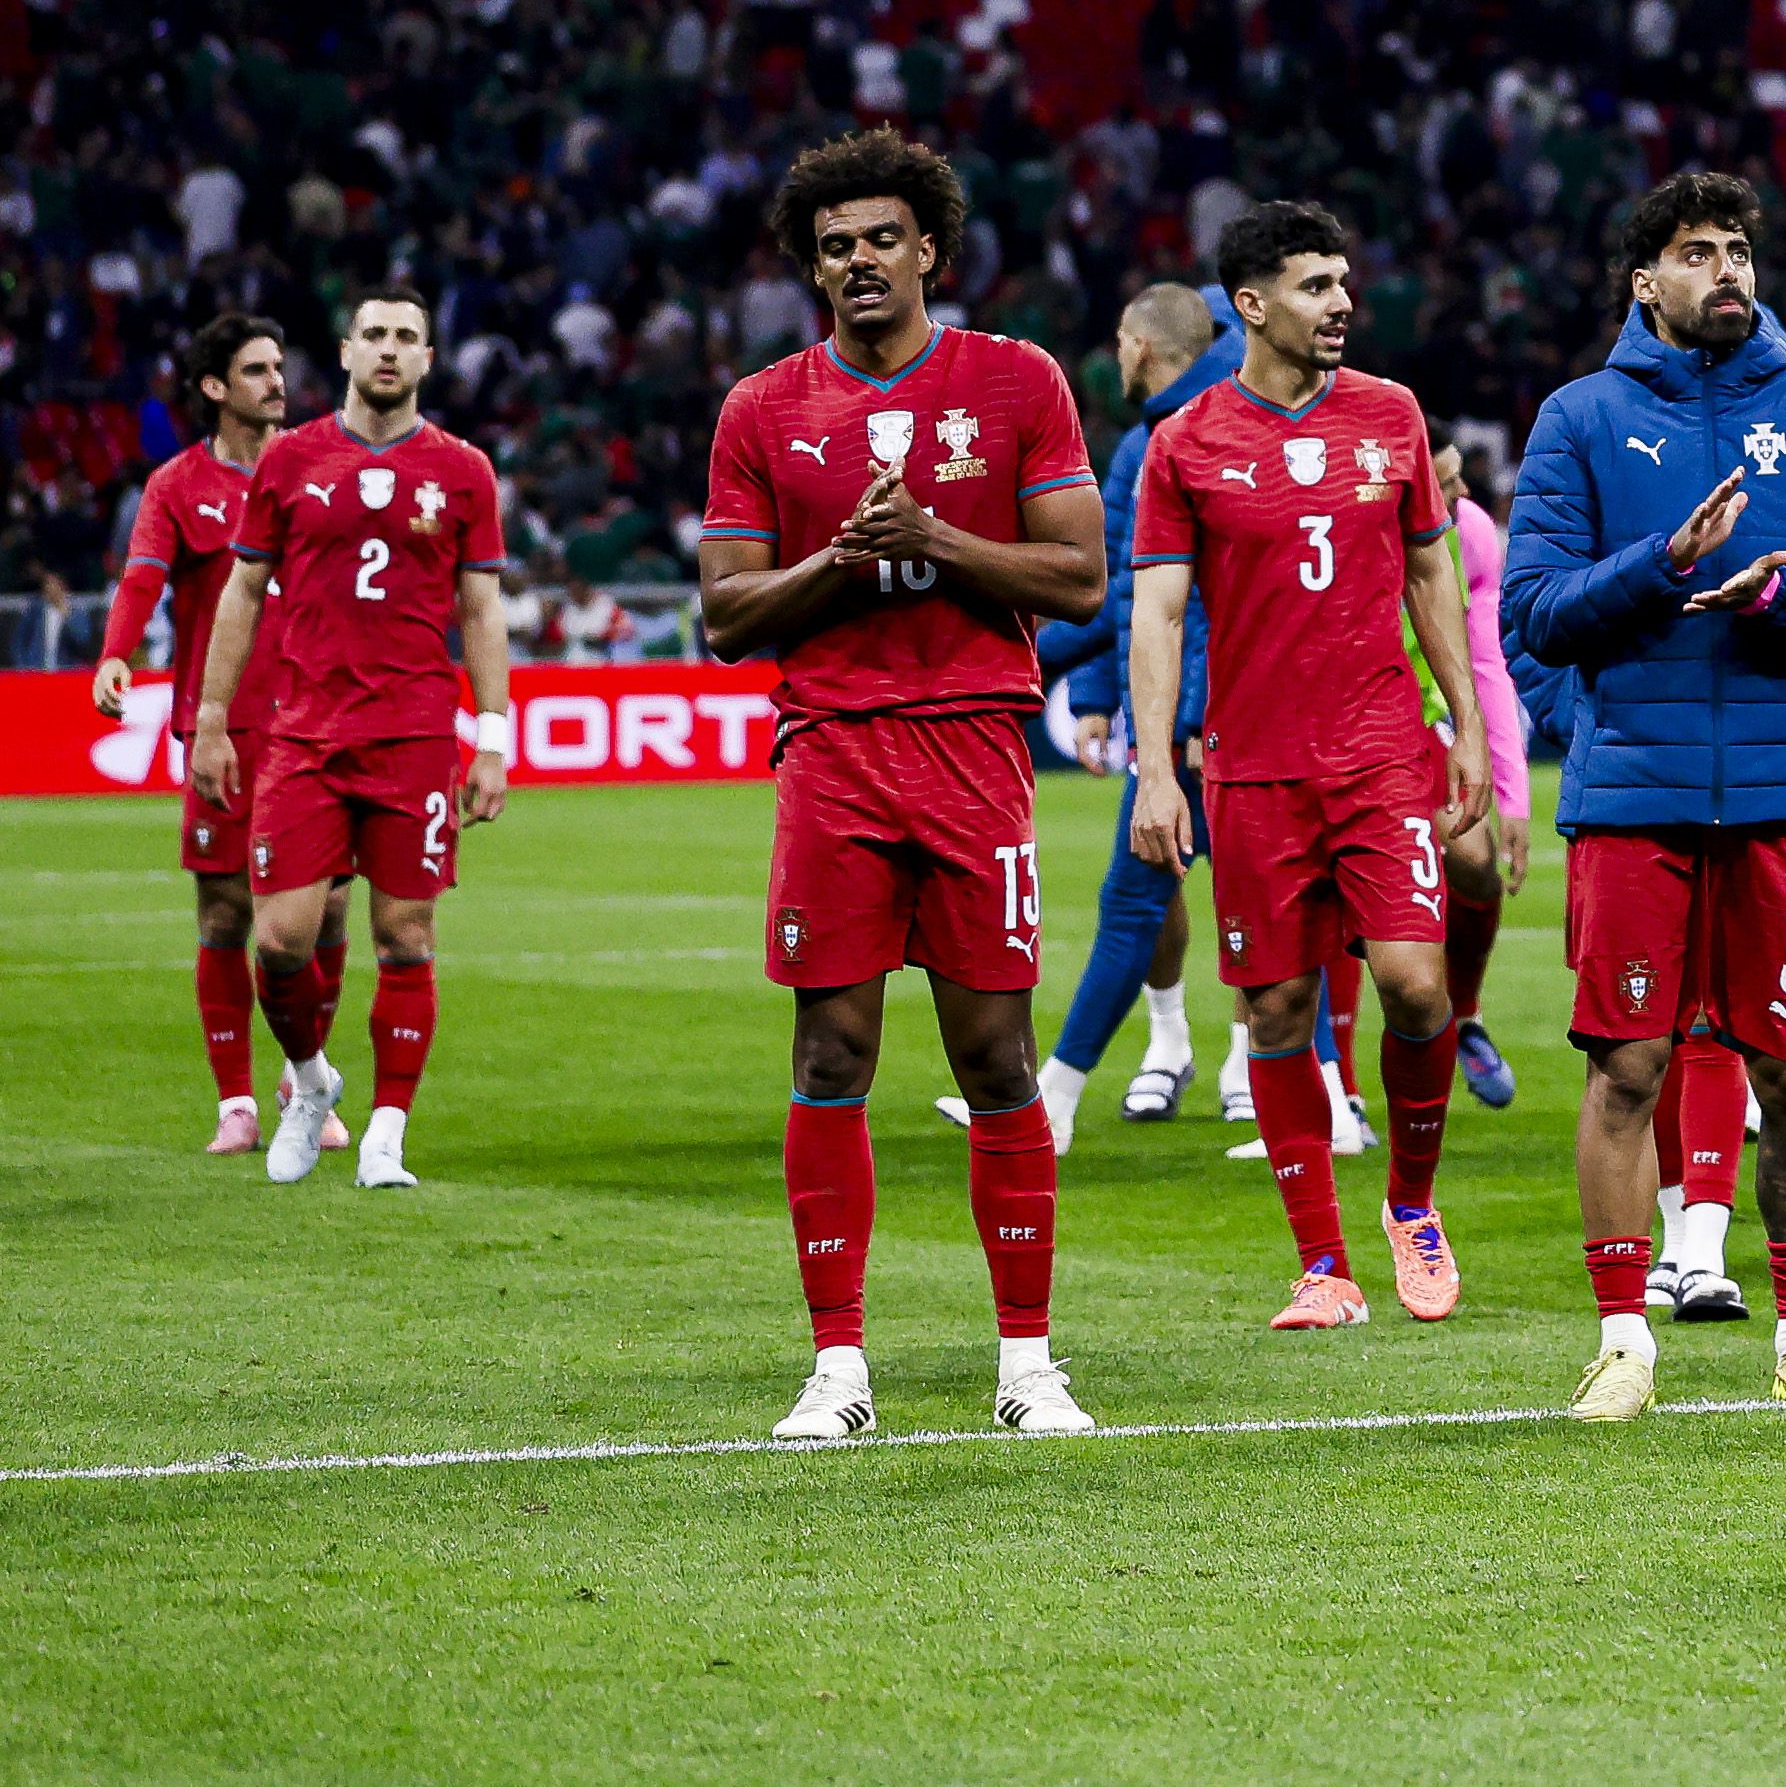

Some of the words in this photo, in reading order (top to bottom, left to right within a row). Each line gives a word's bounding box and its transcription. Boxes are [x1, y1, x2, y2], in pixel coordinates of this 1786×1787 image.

[355, 538, 390, 600] 2
[1298, 515, 1334, 592] 3
[422, 791, 448, 856] 2
[1403, 815, 1439, 889] 3
[994, 841, 1040, 931] 13
